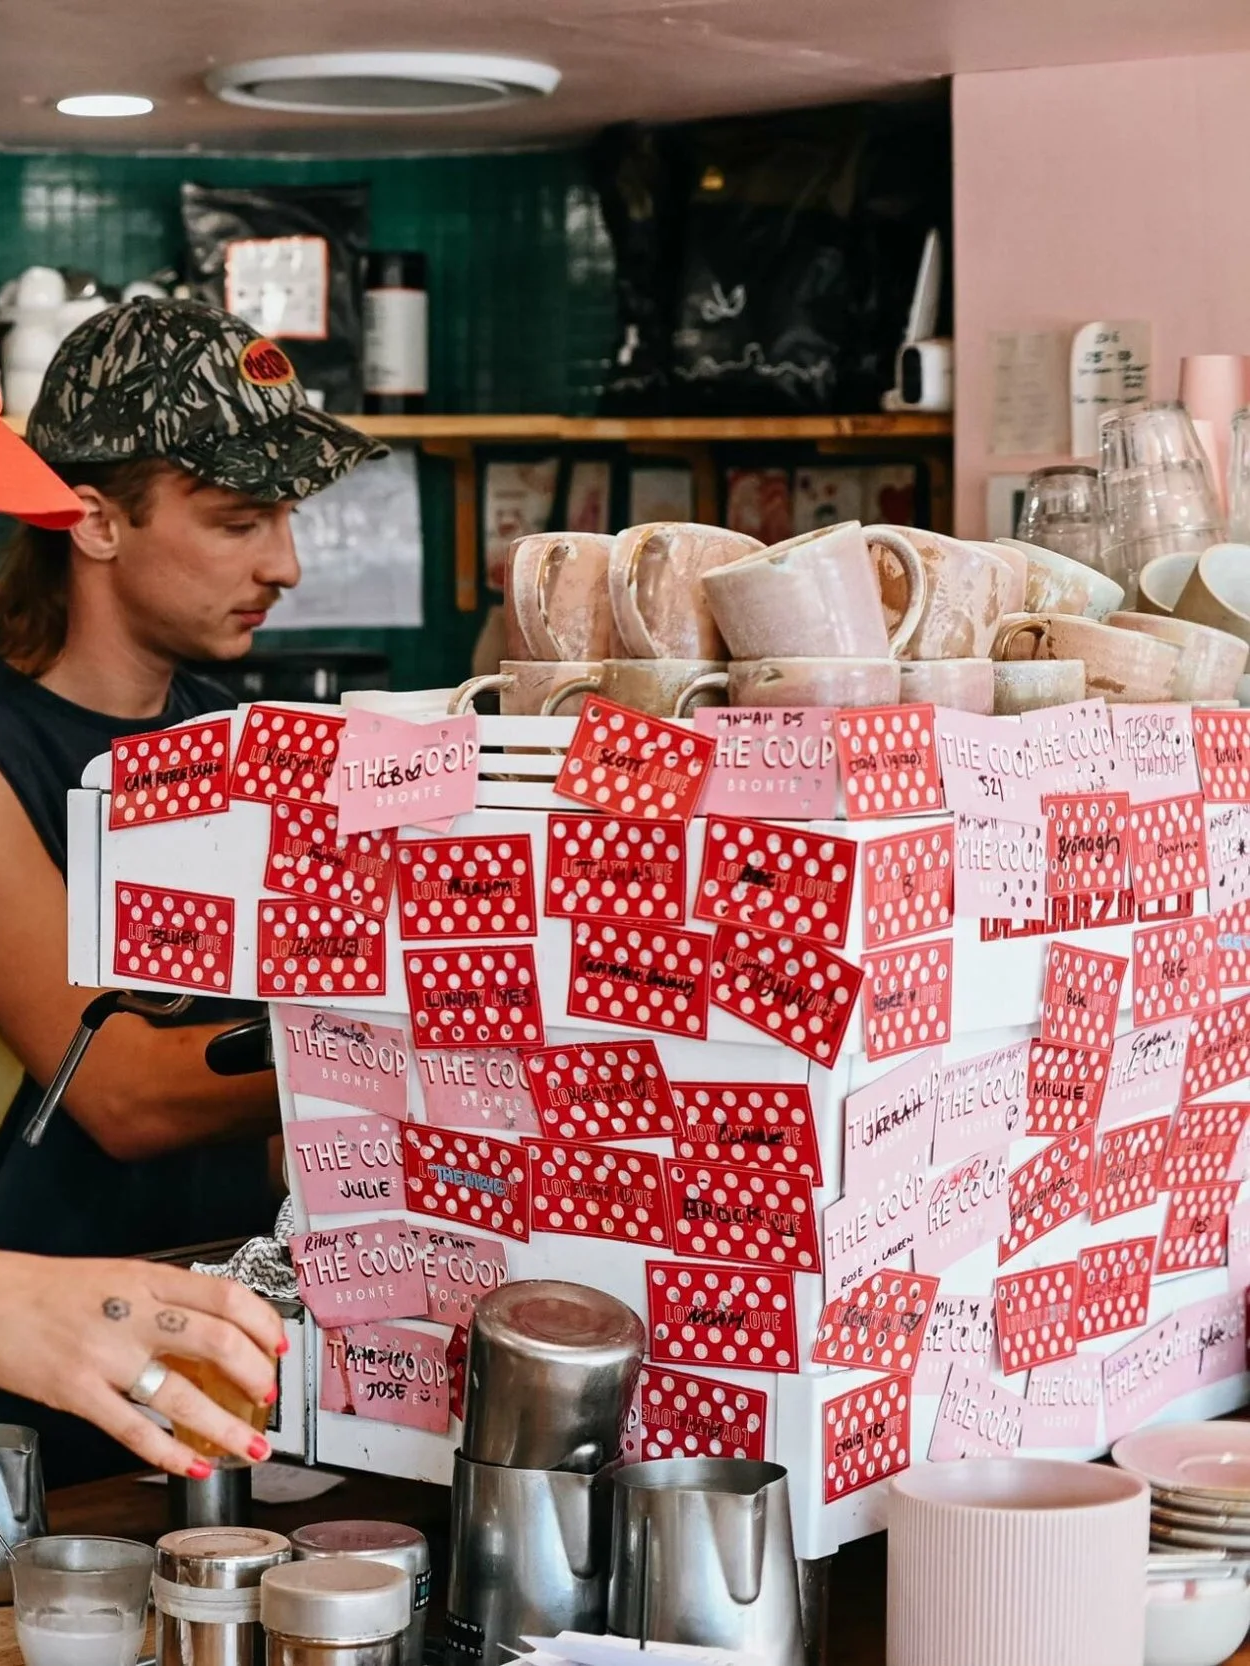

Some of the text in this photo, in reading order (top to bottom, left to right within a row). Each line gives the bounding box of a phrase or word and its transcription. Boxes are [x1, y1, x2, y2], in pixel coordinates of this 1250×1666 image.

[343, 754, 400, 792] THE
[410, 740, 478, 777] COOP
[714, 734, 838, 770] HE COOP
[941, 732, 981, 770] THE
[988, 742, 1034, 780] COOP
[377, 785, 442, 808] BRONTE
[651, 766, 691, 798] LOVE
[727, 778, 799, 795] BRONTE
[351, 852, 385, 879] LOVE
[958, 838, 992, 871] THE
[717, 860, 789, 893] LOTY
[794, 875, 838, 904] LOVE
[1161, 960, 1189, 981] REG
[287, 1026, 407, 1079] THE COOP
[322, 1067, 381, 1093] BRONTE
[420, 1055, 531, 1091] THE CO
[1033, 1082, 1086, 1101] MILLIE
[296, 1141, 351, 1172] THE
[340, 1179, 391, 1200] JULIE
[827, 1173, 925, 1261] THE COOP
[296, 1242, 417, 1288] THE COOP
[447, 1253, 508, 1290] COOP
[840, 1266, 864, 1290] ROSE
[336, 1284, 395, 1304] BRONTE
[740, 1310, 783, 1333] LOVE
[366, 1380, 408, 1401] JOSE
